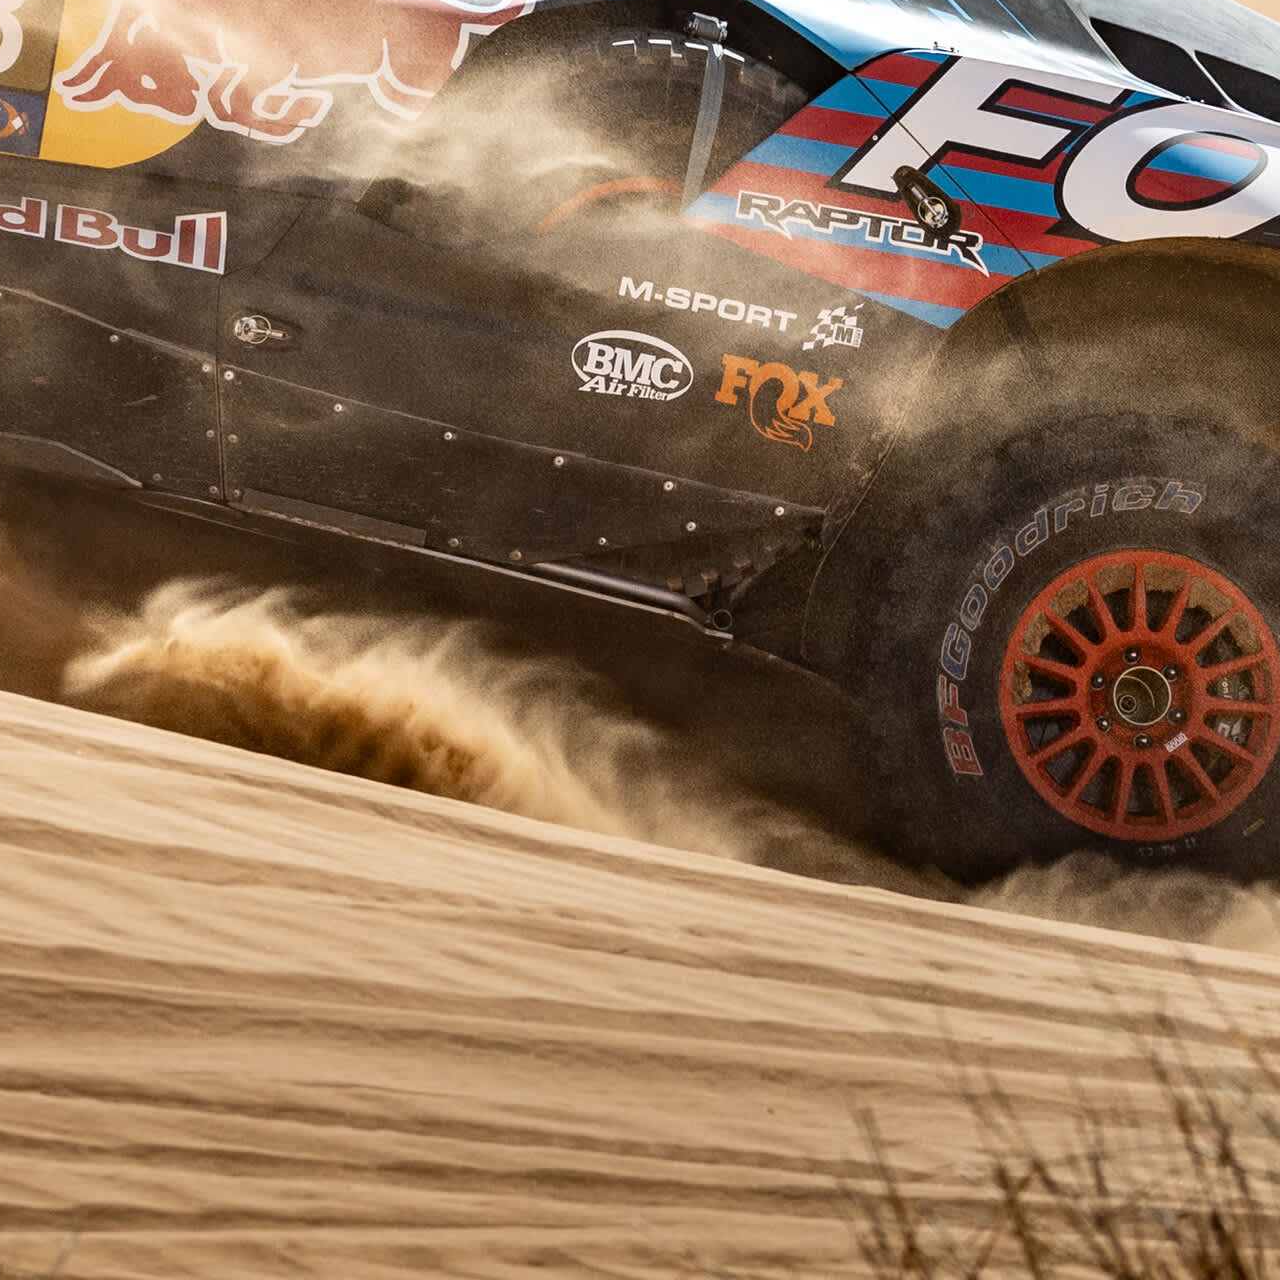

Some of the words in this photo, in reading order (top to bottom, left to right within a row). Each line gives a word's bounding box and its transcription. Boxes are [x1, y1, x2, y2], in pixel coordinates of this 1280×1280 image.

[54, 204, 227, 275] Bull
[735, 190, 990, 277] RAPTOR
[619, 276, 797, 332] M-SPORT
[578, 376, 630, 397] Air
[628, 384, 671, 401] Filter
[582, 341, 684, 390] BMC
[714, 353, 844, 452] FOX
[936, 480, 1204, 778] BFGoodrich
